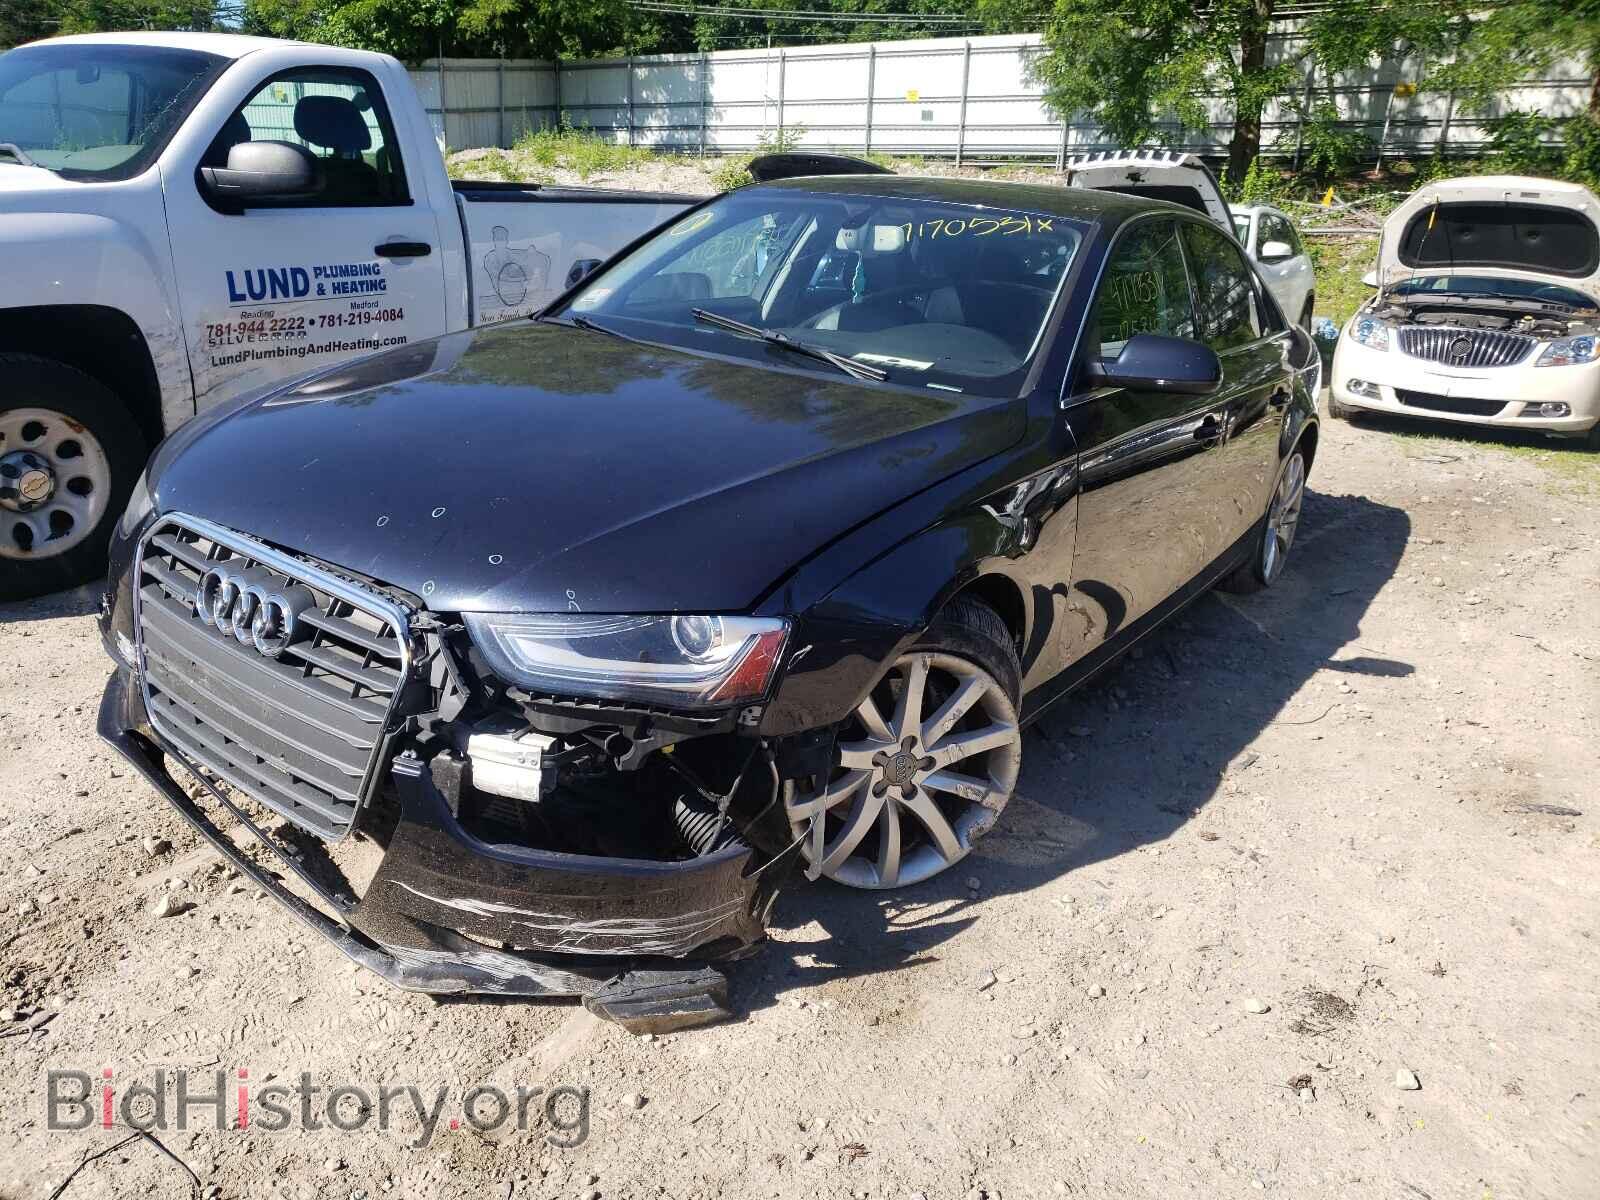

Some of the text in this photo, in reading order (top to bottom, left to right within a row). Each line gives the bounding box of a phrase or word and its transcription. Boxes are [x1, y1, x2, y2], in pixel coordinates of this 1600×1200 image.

[313, 263, 381, 279] PLUMBING
[225, 267, 310, 302] LUND
[316, 278, 387, 295] & HEATING
[350, 300, 379, 310] Medford
[241, 309, 276, 320] Reading
[318, 308, 404, 328] 781-219-4084
[211, 335, 407, 367] LundPlumbingAndHeating.com
